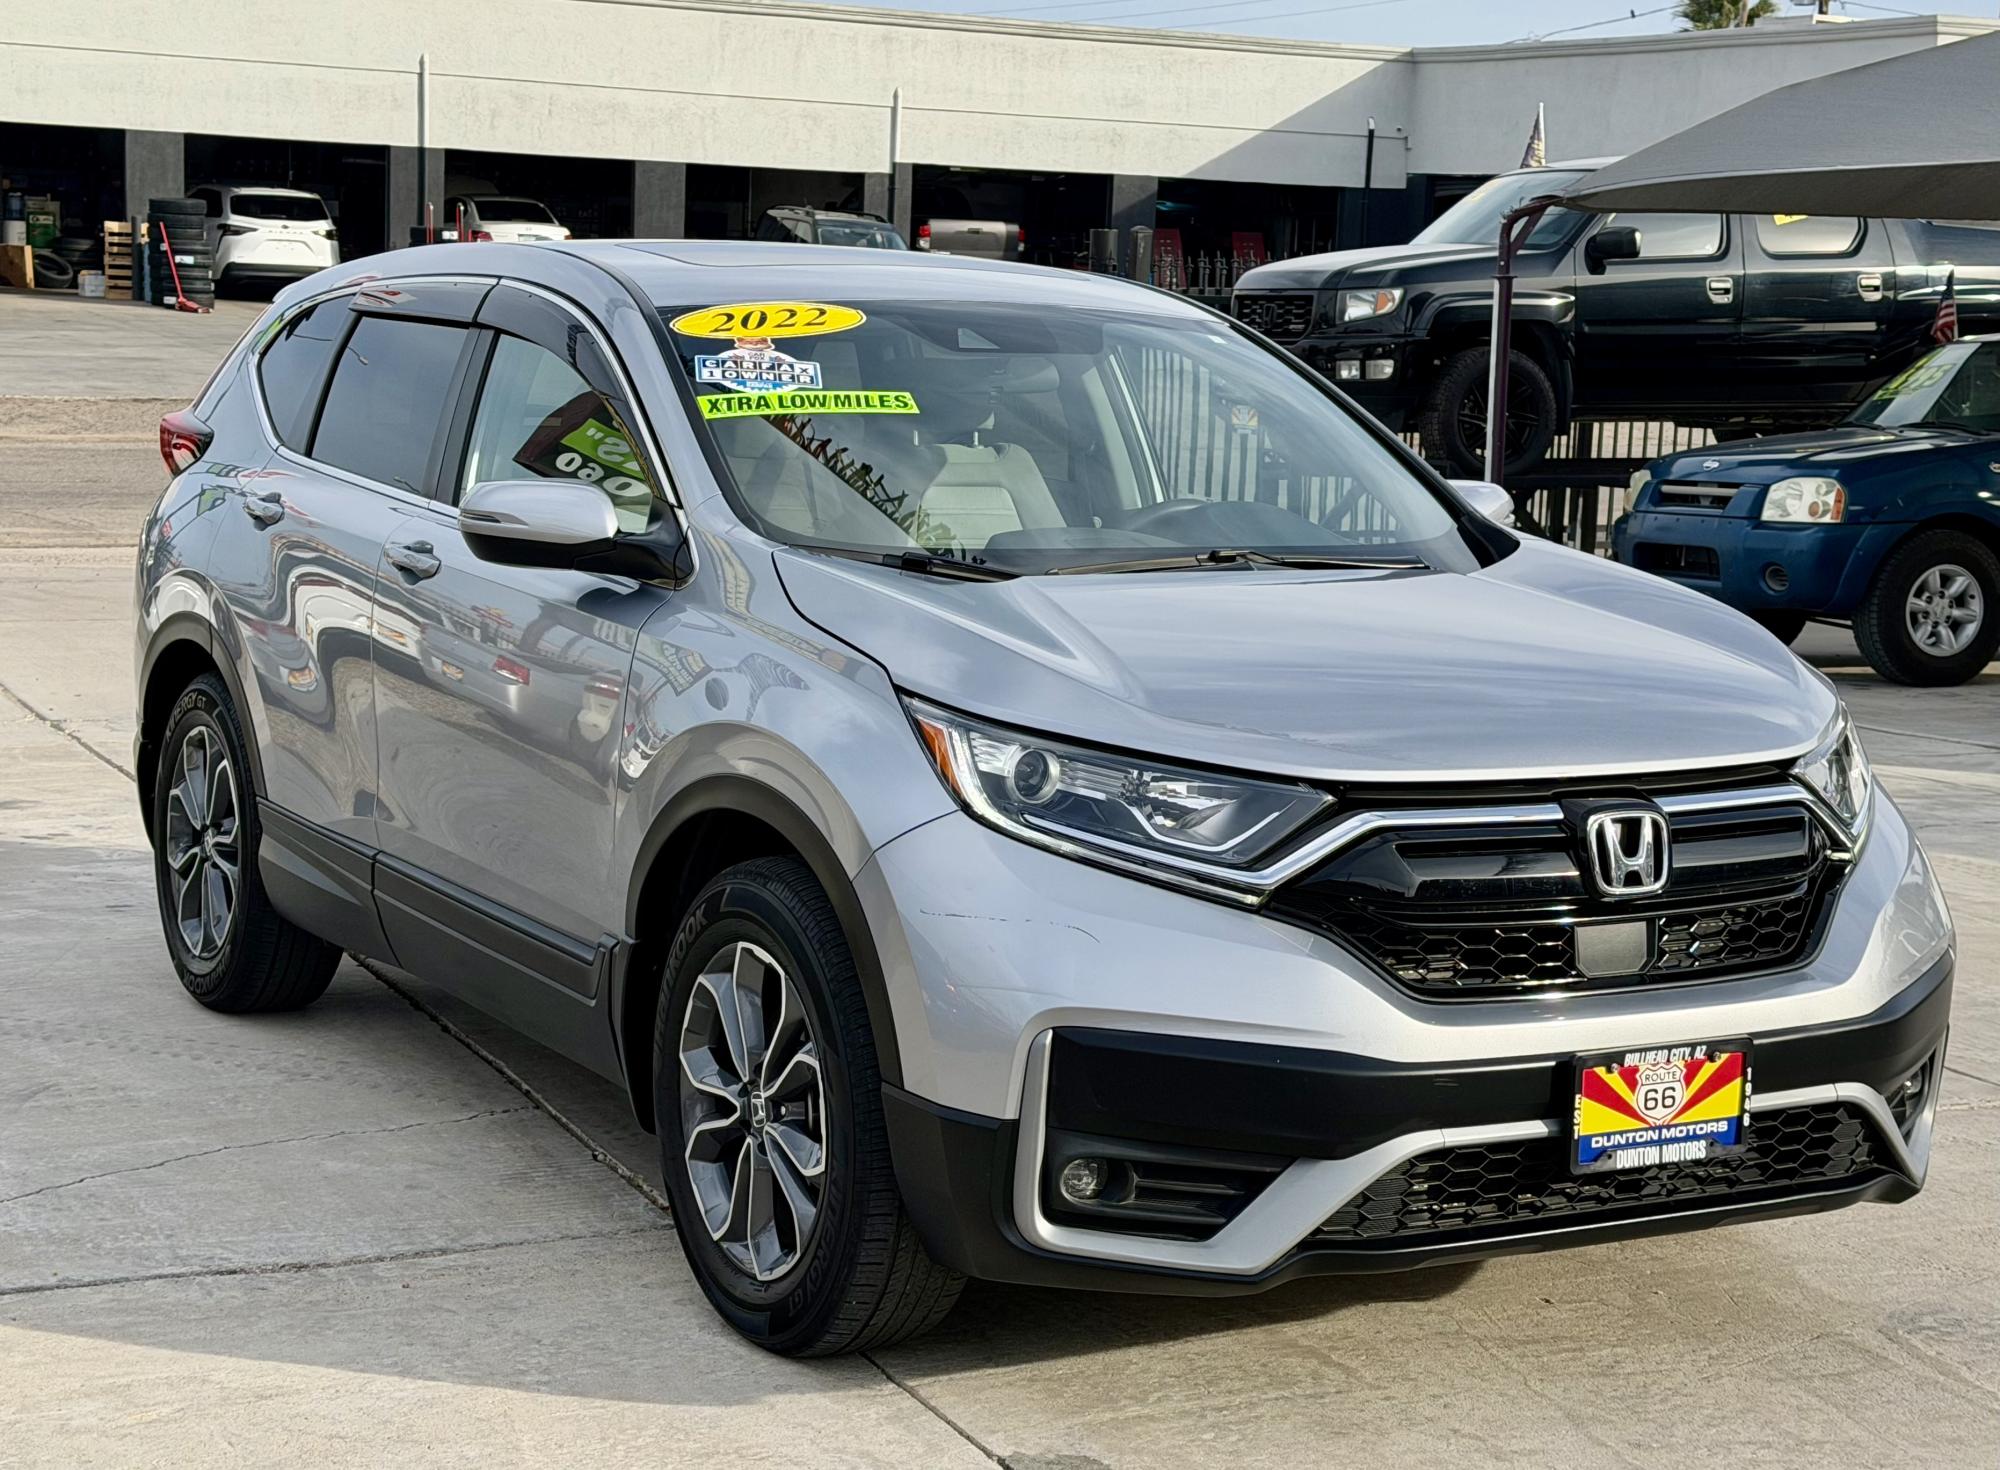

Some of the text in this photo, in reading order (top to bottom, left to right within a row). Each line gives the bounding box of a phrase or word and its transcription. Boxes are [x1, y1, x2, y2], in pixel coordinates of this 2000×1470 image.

[709, 307, 828, 333] 2022
[704, 360, 810, 374] CARFAX
[724, 370, 812, 384] OWNER
[707, 394, 910, 413] XTRA LOW MILES
[1624, 1049, 1670, 1067] BULLHEAD
[1694, 1046, 1707, 1060] AZ
[1644, 1070, 1677, 1083] ROUTE
[1643, 1086, 1676, 1111] 66
[1743, 1067, 1752, 1127] 1946
[1573, 1094, 1581, 1139] EST
[1591, 1120, 1728, 1148] DUNTON MOTORS
[1616, 1140, 1707, 1168] DUNTON MOTORS
